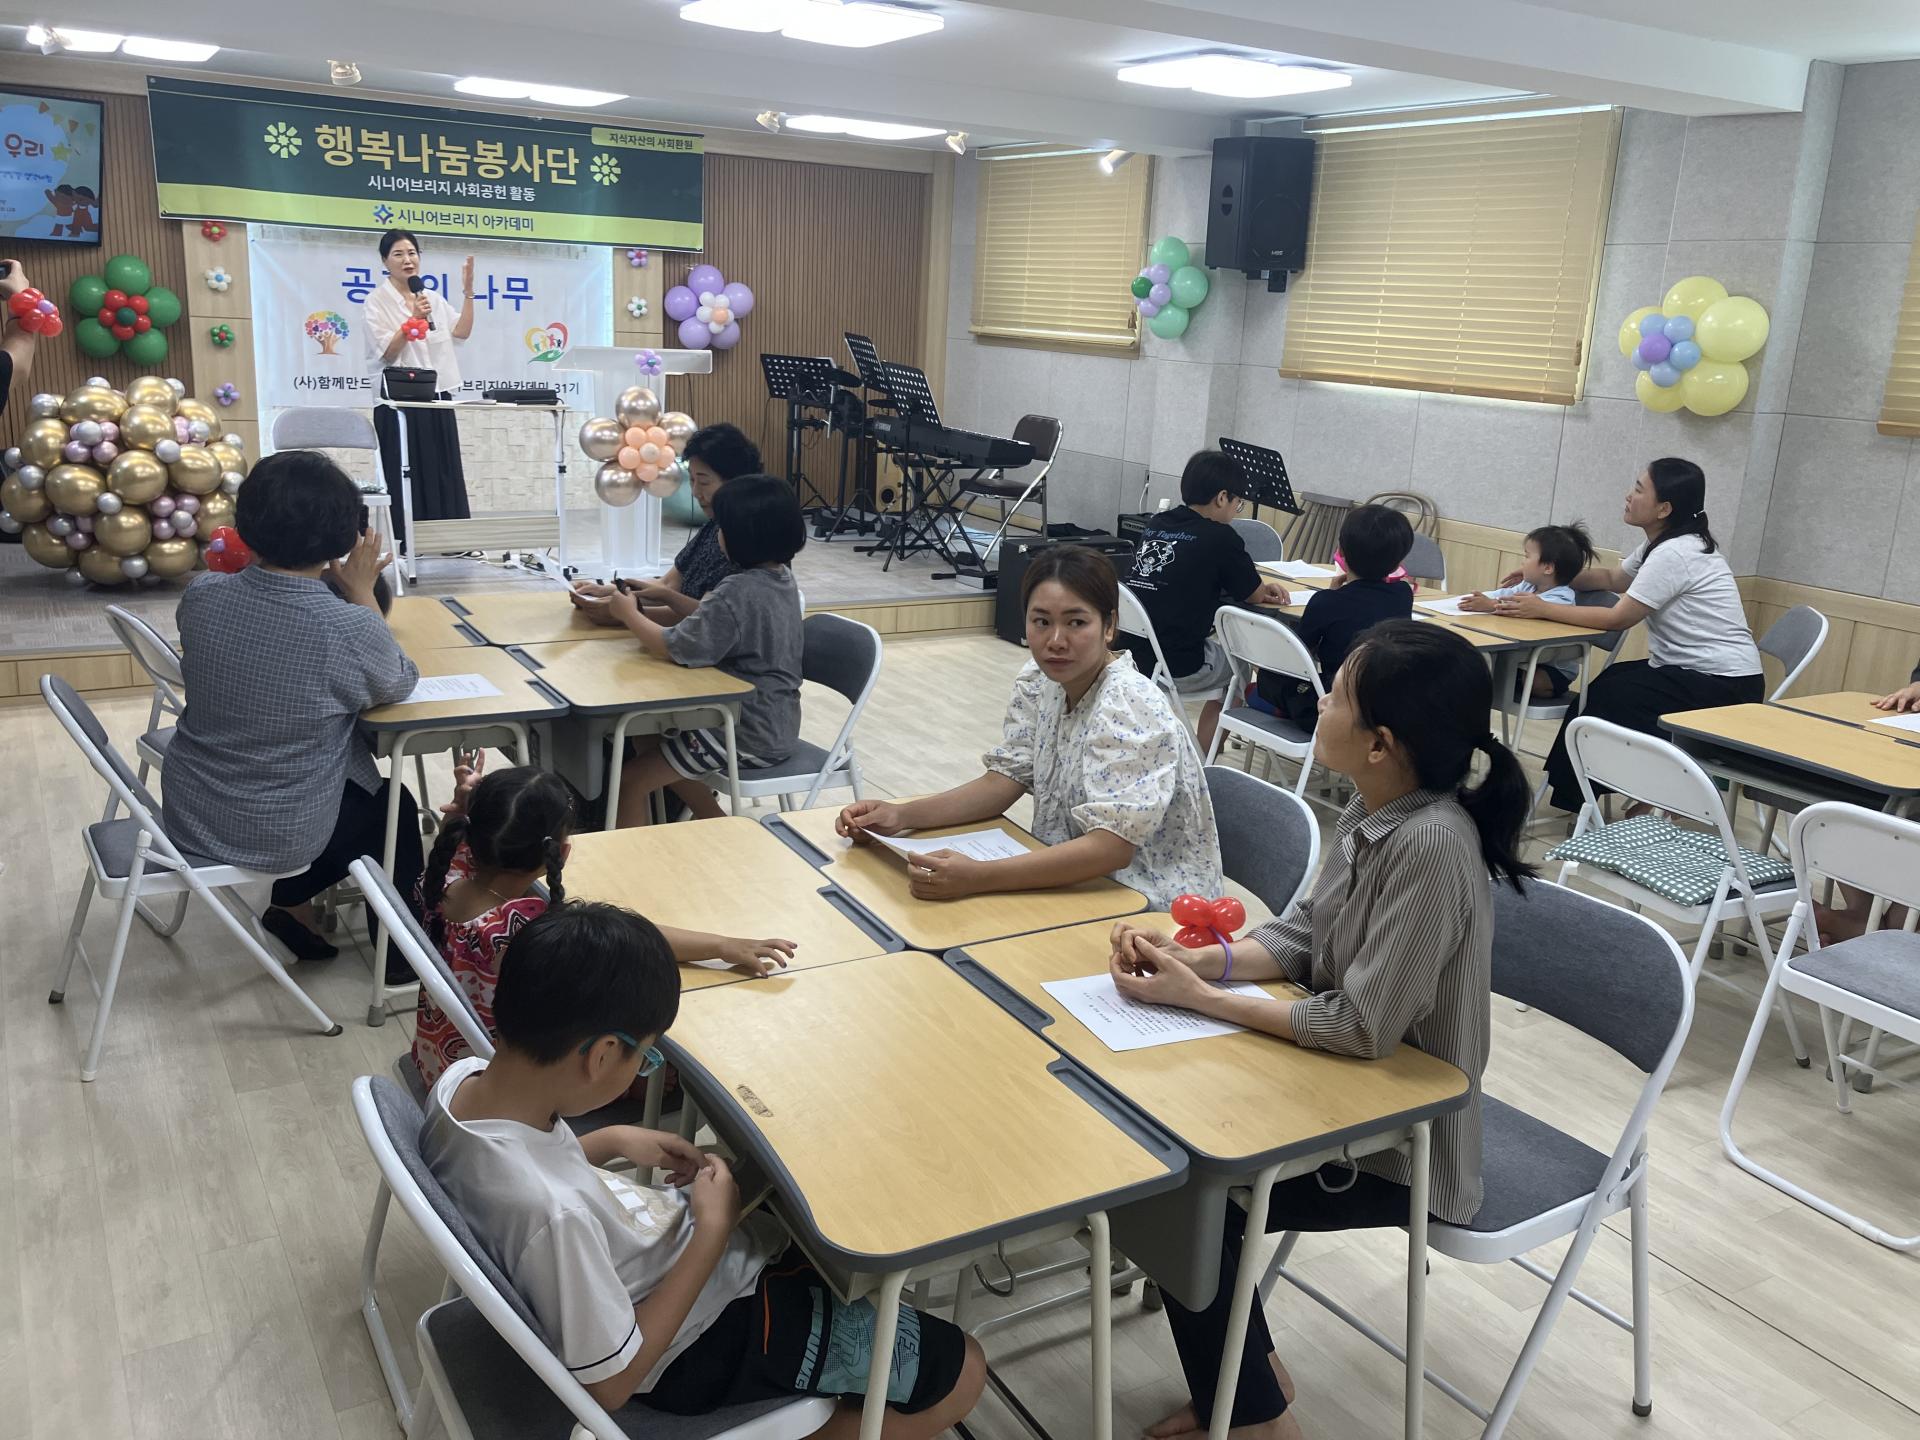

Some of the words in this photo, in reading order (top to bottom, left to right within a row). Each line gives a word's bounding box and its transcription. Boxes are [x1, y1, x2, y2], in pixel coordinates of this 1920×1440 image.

[4, 133, 44, 158] 우리
[609, 132, 655, 147] 지식자산의
[657, 138, 693, 150] 사회환원
[314, 124, 580, 186] 행복나눔봉사단
[368, 175, 451, 195] 시니어브리지
[454, 182, 507, 200] 사회공헌
[509, 186, 536, 202] 활동
[398, 209, 479, 228] 시니어브리지
[482, 214, 534, 232] 아카데미
[341, 267, 448, 304] 공의
[293, 375, 372, 390] (사)함께만드
[555, 382, 579, 395] 31기
